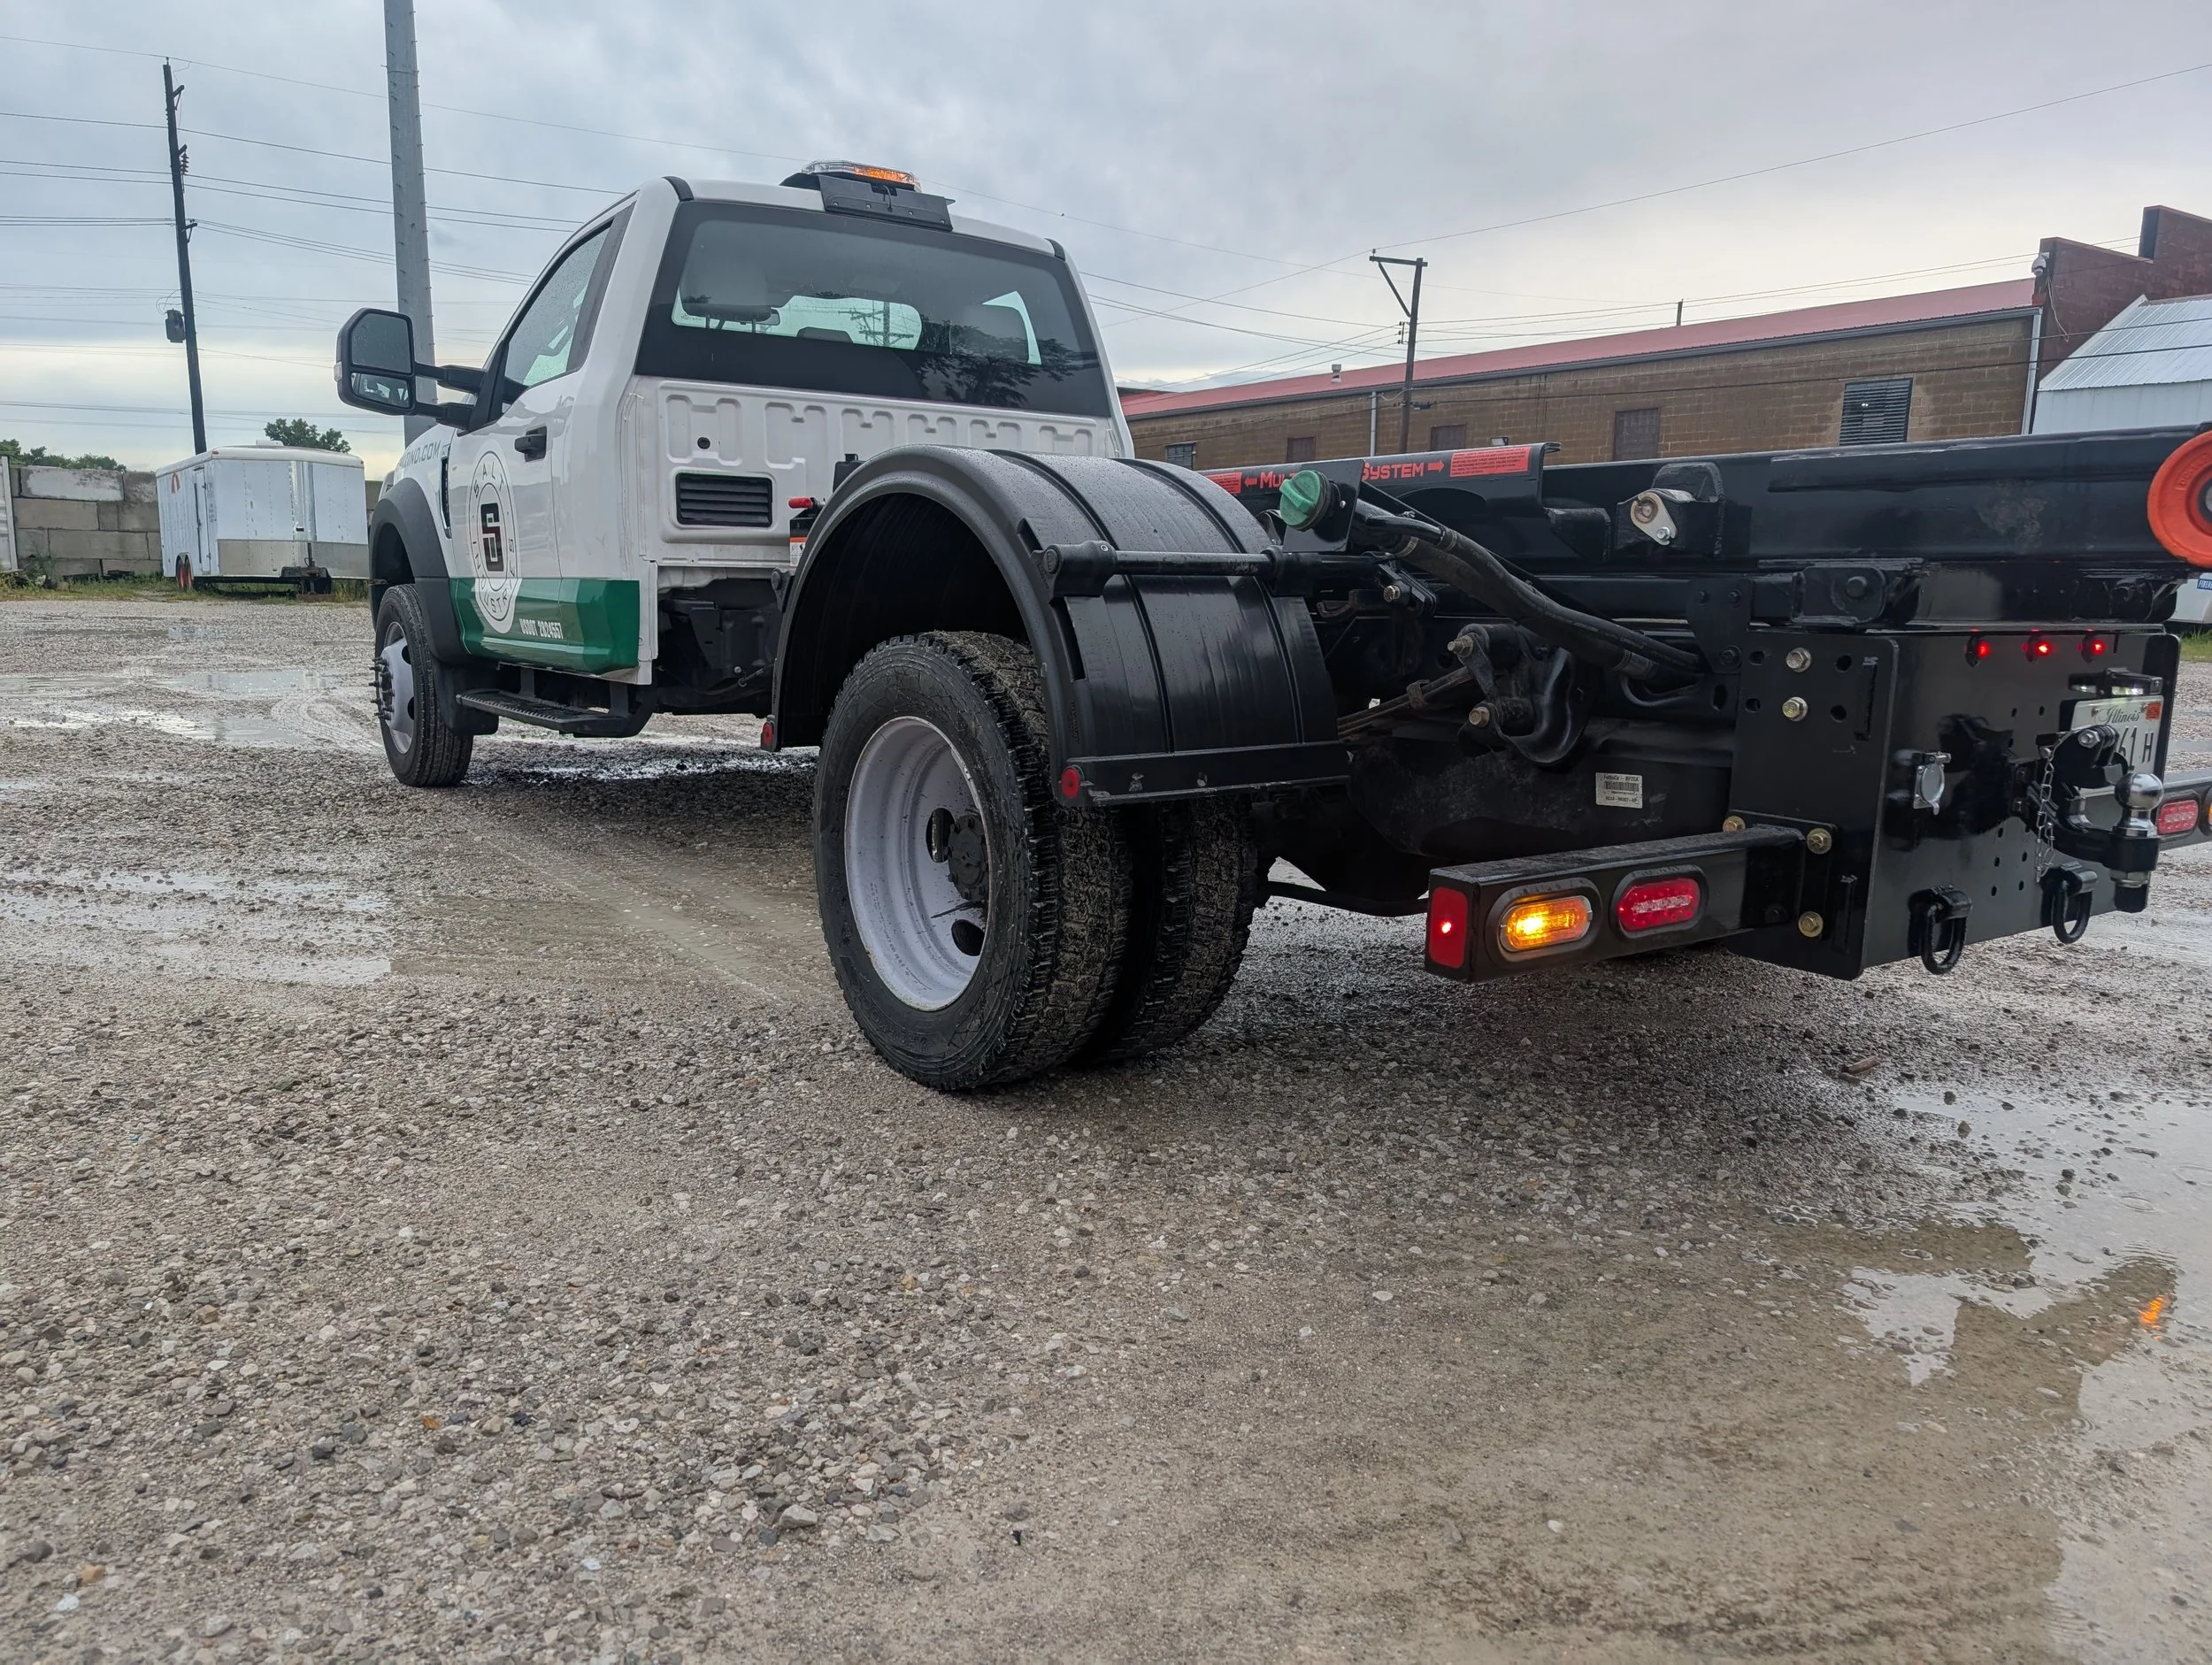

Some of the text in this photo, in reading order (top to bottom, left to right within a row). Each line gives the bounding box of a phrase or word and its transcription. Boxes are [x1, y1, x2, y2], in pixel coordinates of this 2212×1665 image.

[472, 461, 505, 498] SALT
[472, 538, 516, 614] INDUSTRIES
[518, 618, 538, 637] USDOT
[2094, 705, 2140, 725] Illinois
